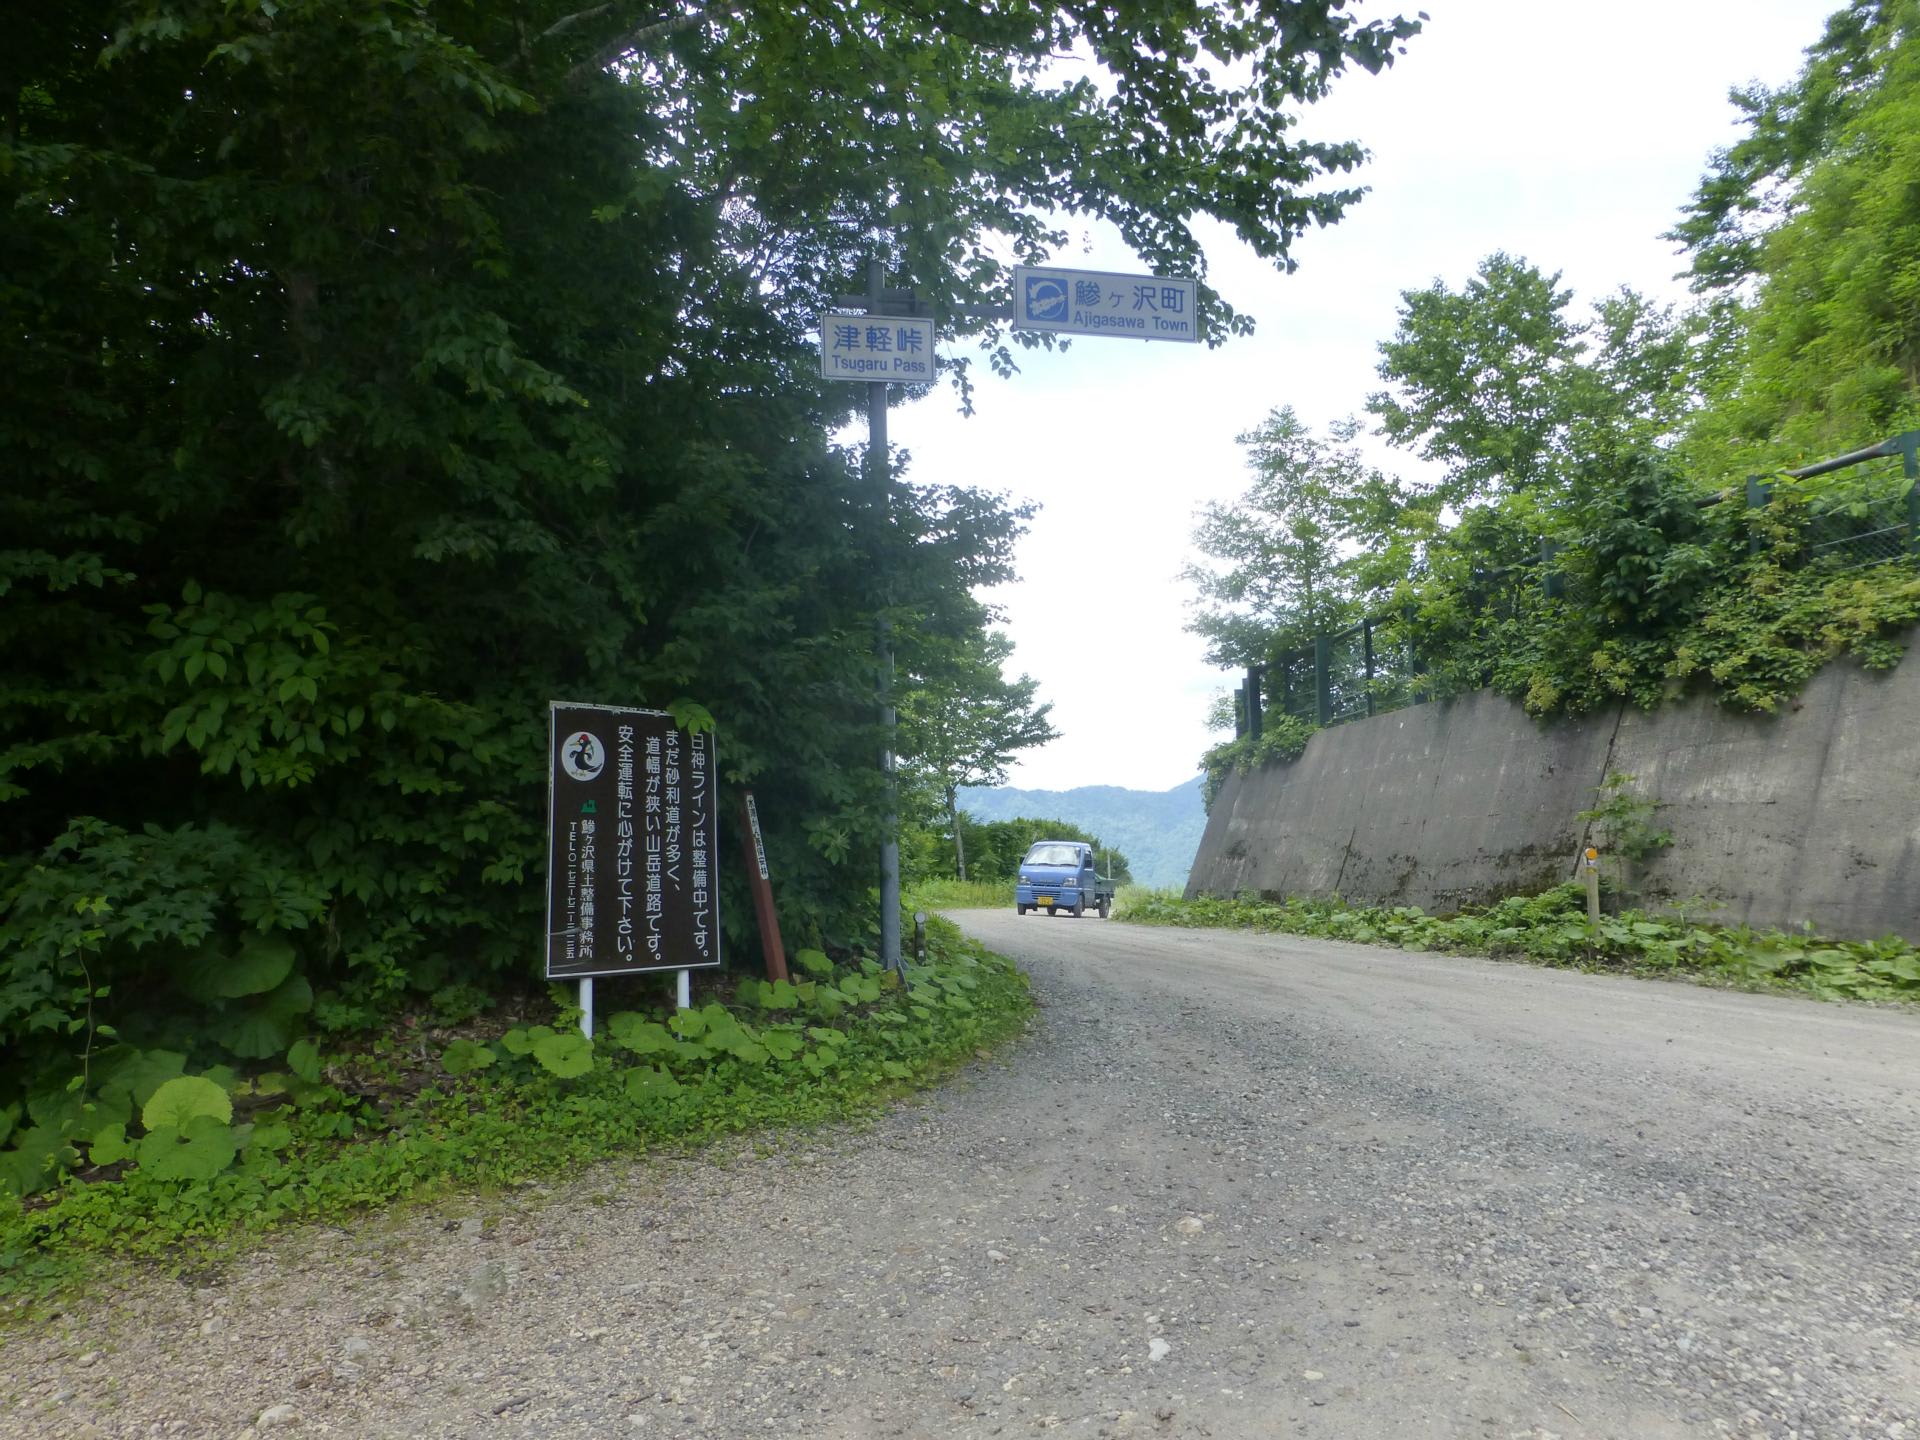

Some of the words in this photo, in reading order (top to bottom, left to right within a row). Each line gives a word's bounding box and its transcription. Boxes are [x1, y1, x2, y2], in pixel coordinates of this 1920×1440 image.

[1073, 310, 1145, 329] Ajigasawa
[1152, 315, 1189, 332] Town
[833, 325, 923, 354] 津軽峠
[832, 354, 888, 373] Tsugaru
[893, 357, 926, 373] Pass
[665, 729, 681, 891] まだ砂利道が多く、
[617, 724, 634, 961] 安全運転に心がけて下さい。
